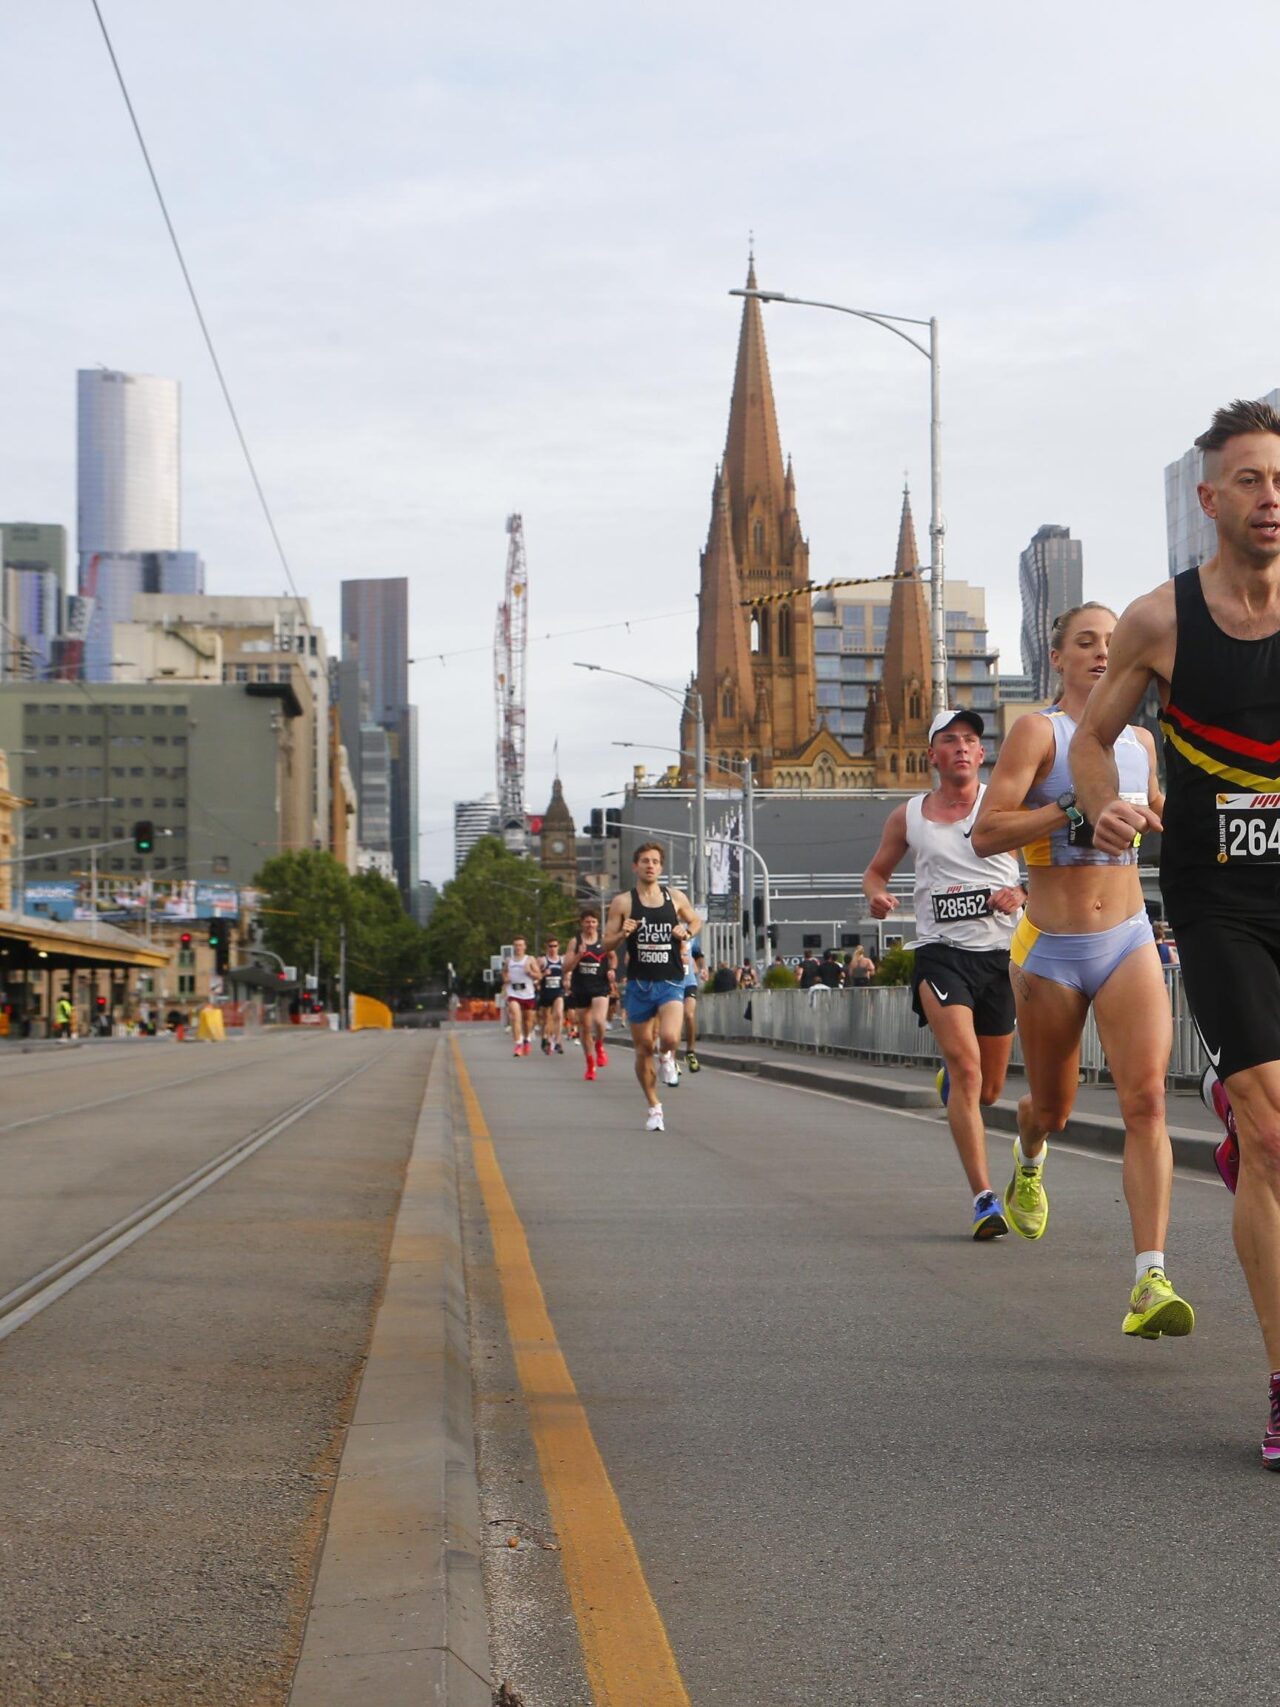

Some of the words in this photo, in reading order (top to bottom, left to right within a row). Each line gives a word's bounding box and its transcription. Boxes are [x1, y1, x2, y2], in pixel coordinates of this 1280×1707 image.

[938, 894, 987, 919] 28552
[648, 923, 672, 933] run
[637, 932, 672, 942] crew
[640, 951, 669, 963] 25009
